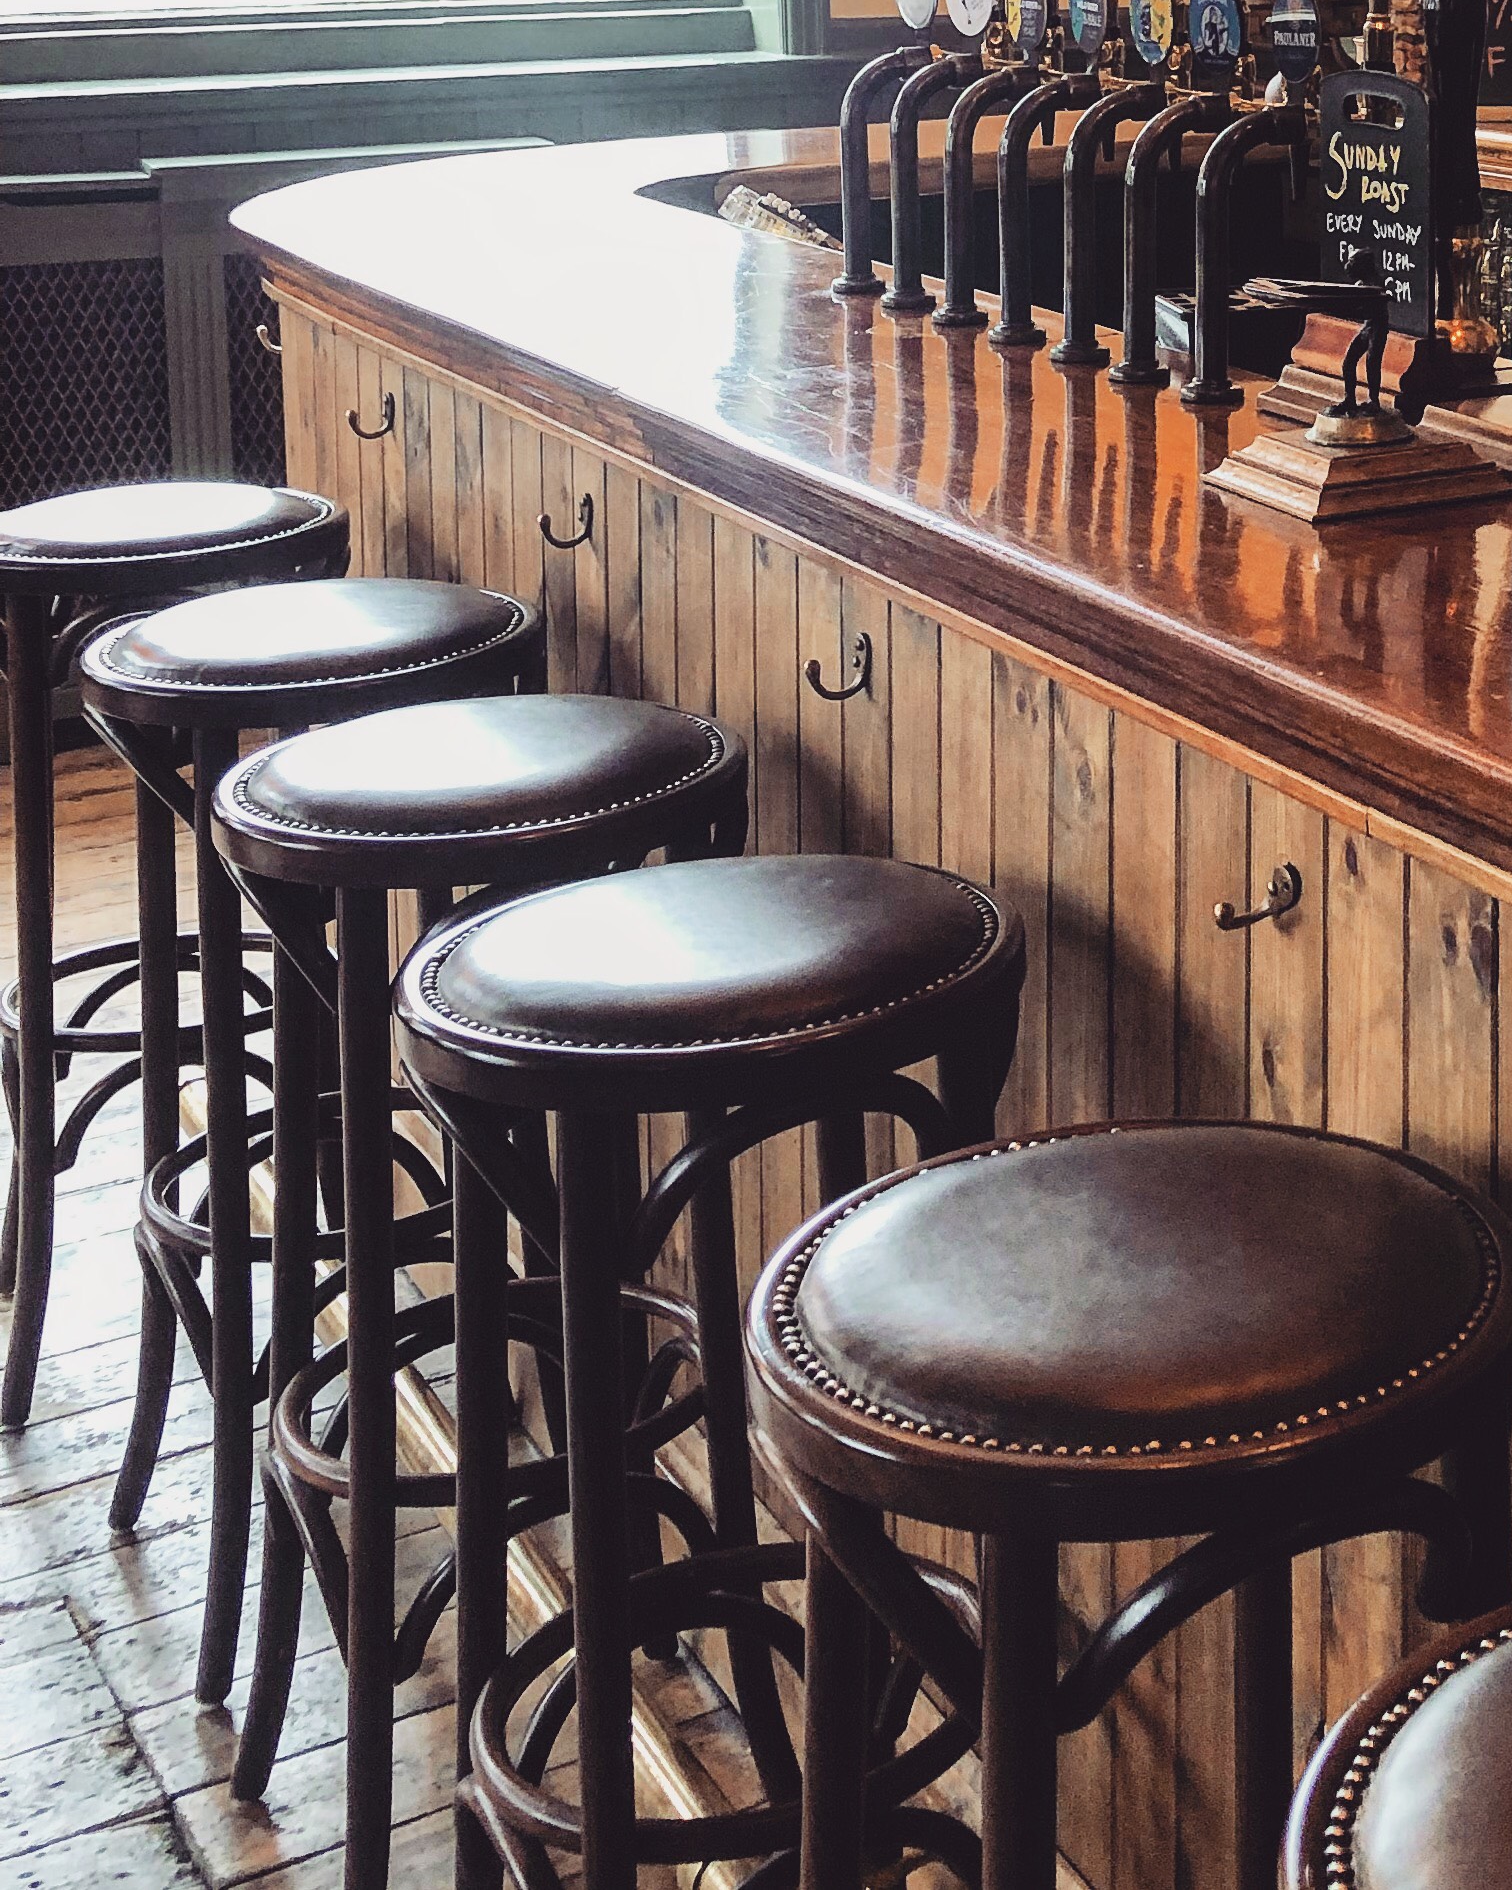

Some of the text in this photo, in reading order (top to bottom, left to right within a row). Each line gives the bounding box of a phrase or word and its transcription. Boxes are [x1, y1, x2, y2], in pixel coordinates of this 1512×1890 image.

[1325, 131, 1401, 201] SUNDAY
[1361, 175, 1410, 214] ROAST
[1326, 212, 1422, 246] EVERY SUNDAY
